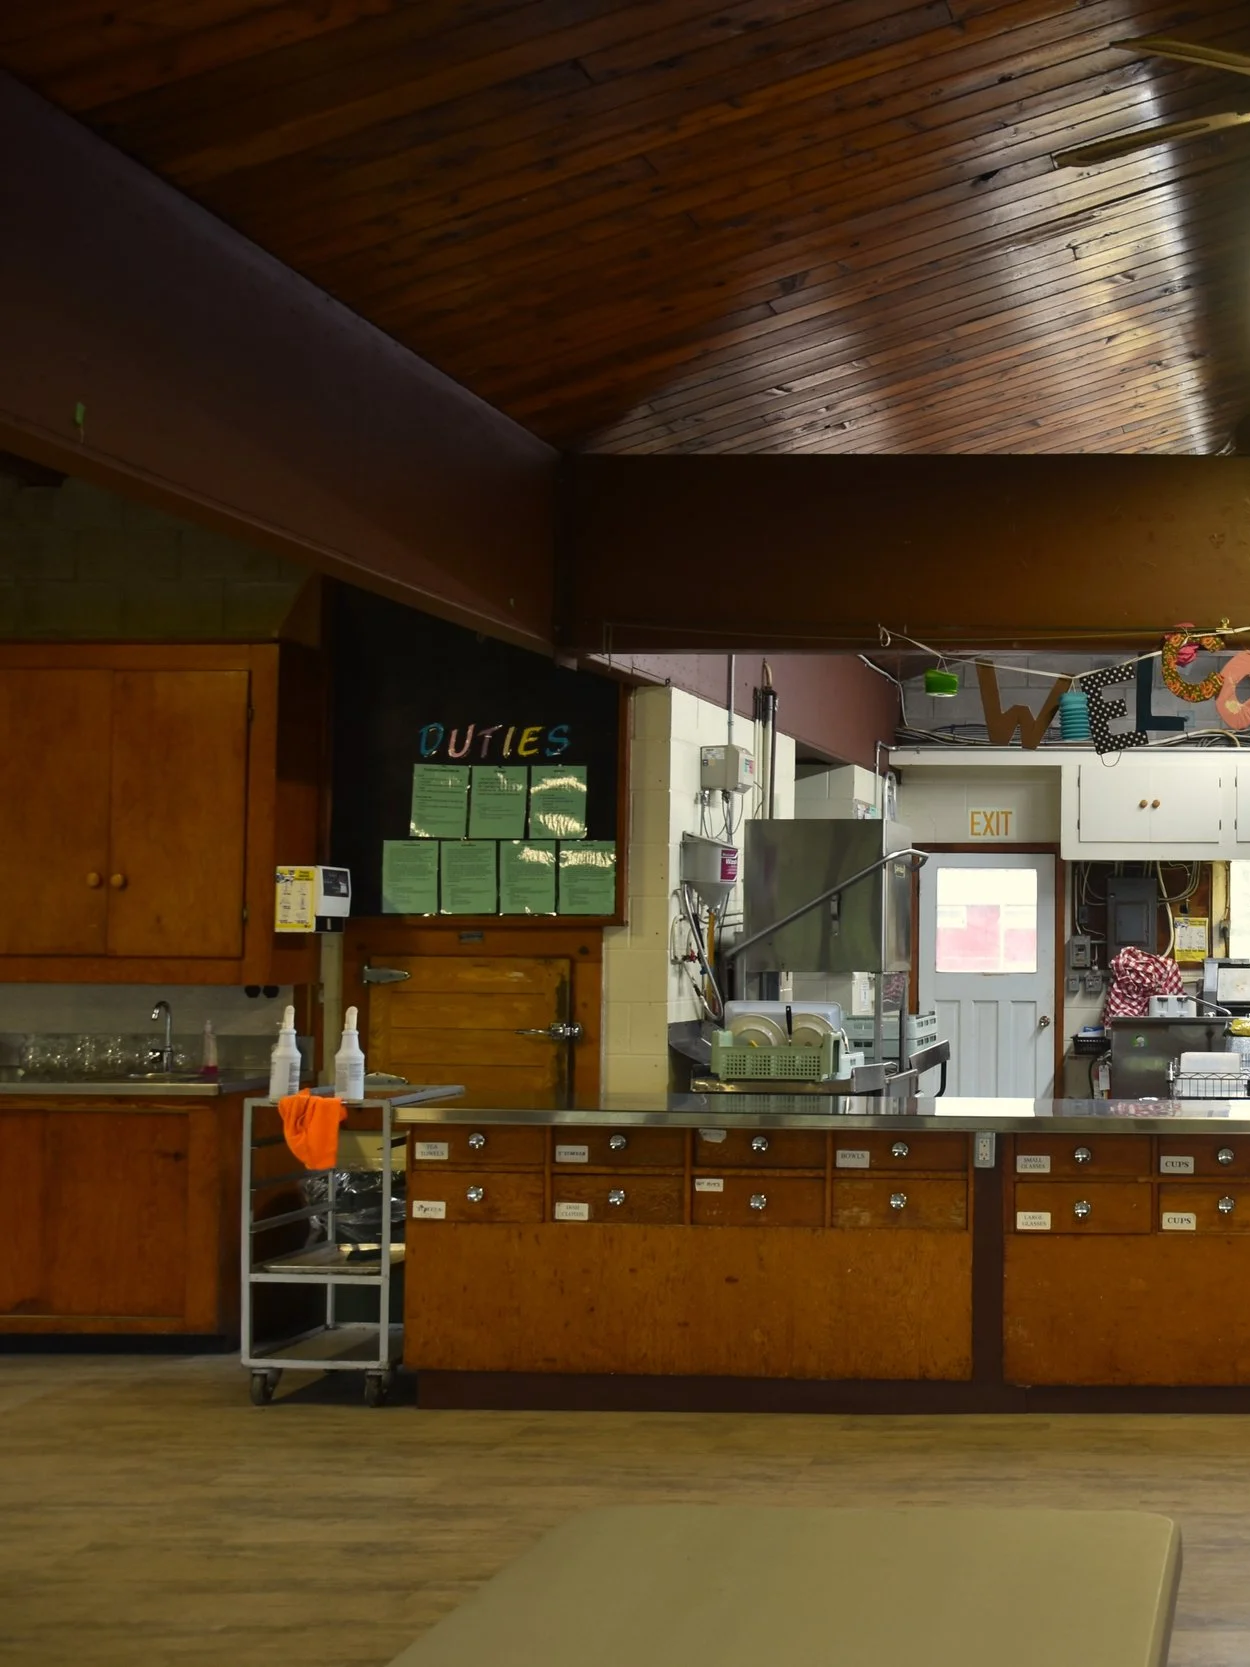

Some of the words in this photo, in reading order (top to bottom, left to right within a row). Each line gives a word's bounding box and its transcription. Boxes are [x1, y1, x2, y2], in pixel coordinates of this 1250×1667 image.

[419, 722, 571, 759] DUTIES
[970, 810, 1013, 836] EXIT
[1165, 1160, 1190, 1168] CUPS
